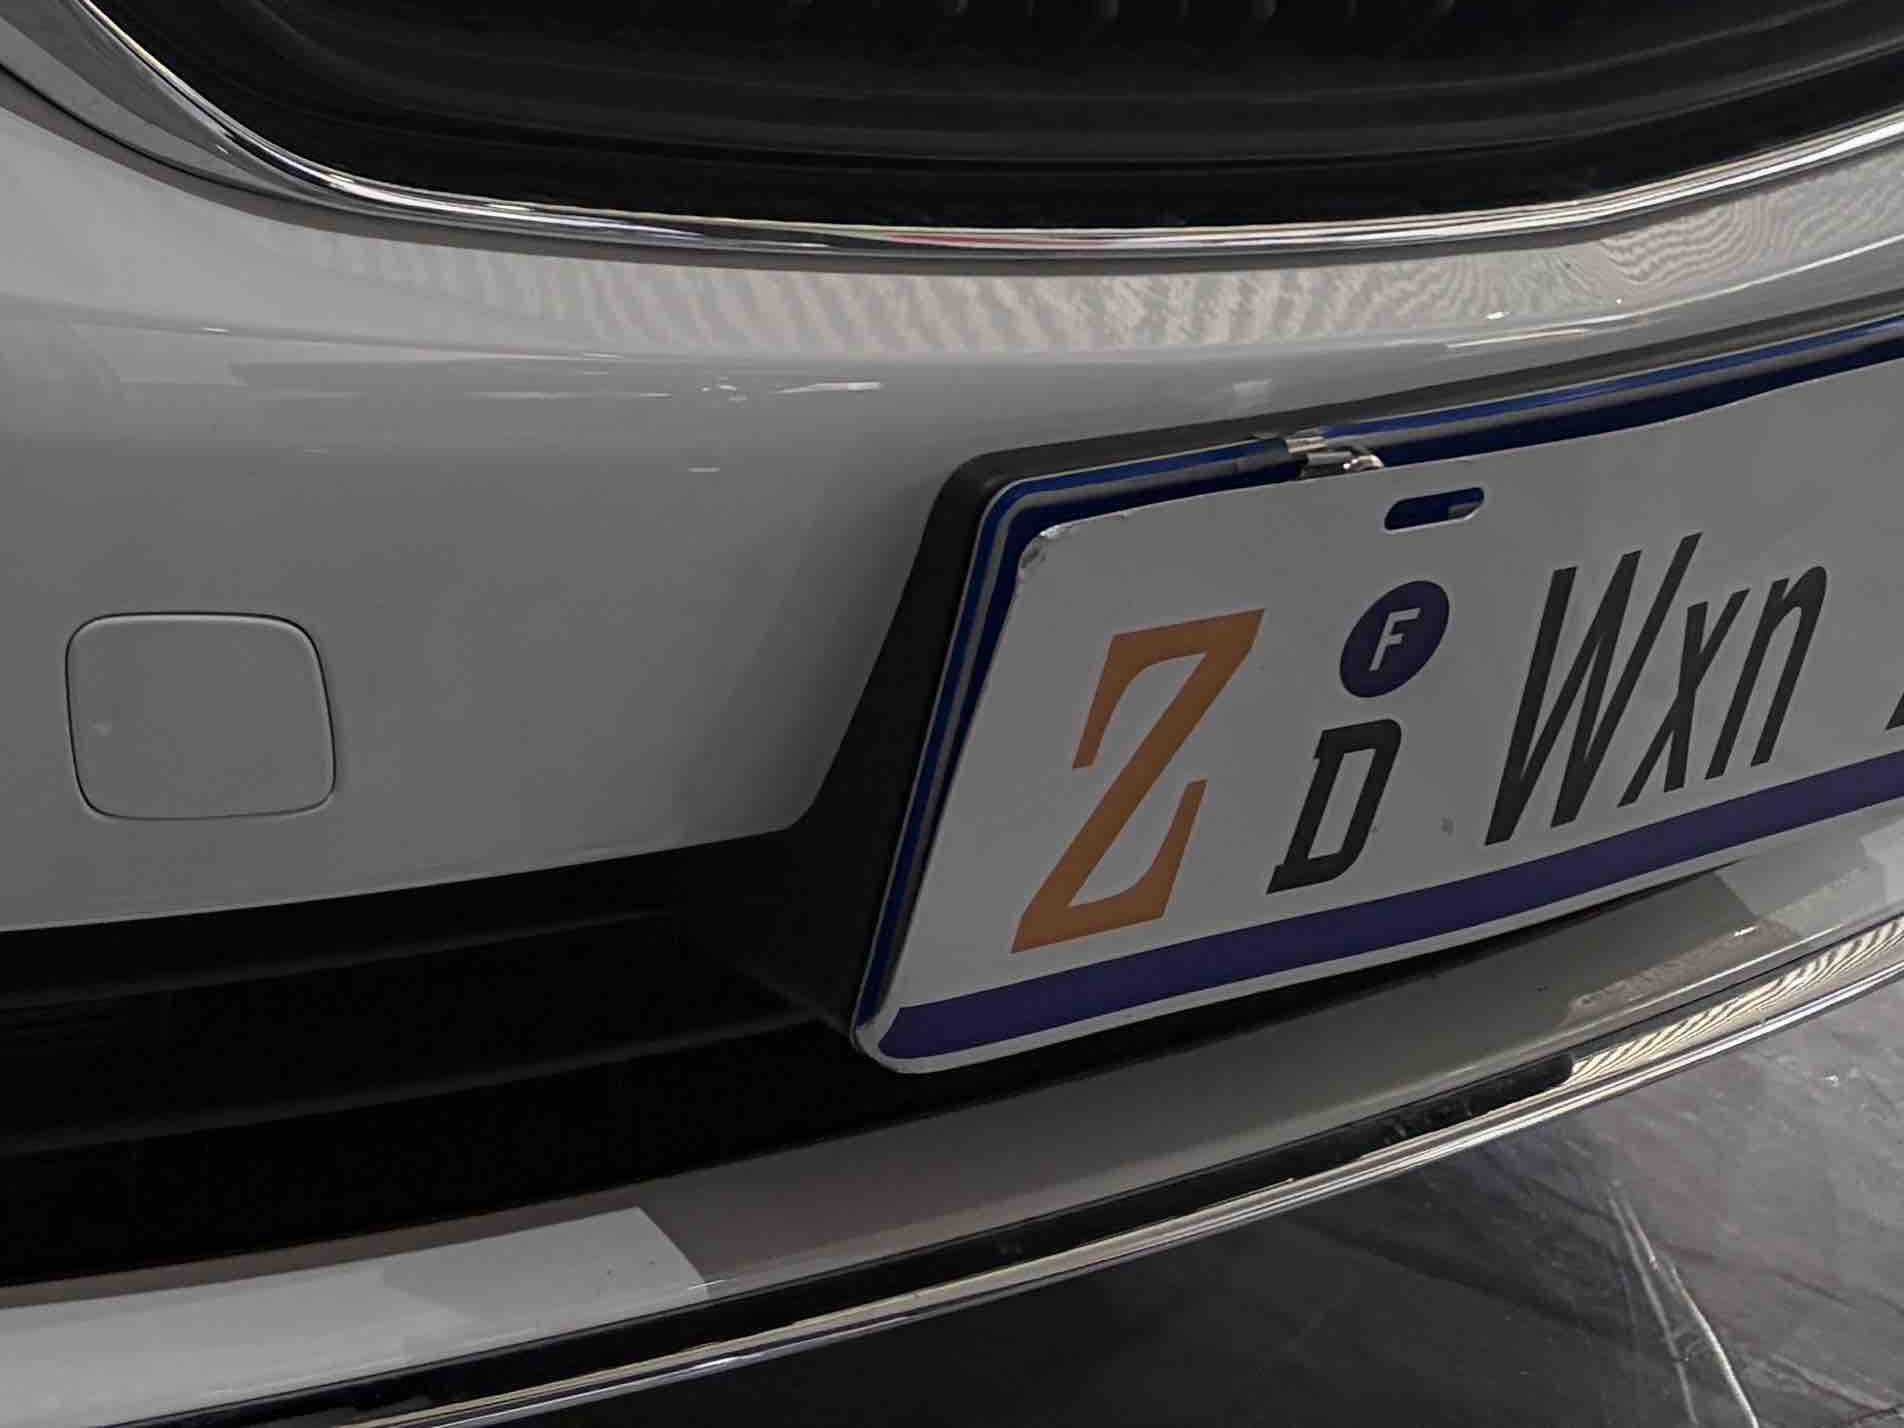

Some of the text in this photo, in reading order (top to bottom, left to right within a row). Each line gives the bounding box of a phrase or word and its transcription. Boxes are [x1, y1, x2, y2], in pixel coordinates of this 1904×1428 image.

[1012, 532, 1828, 953] Z D Wxn
[1368, 607, 1422, 672] F
